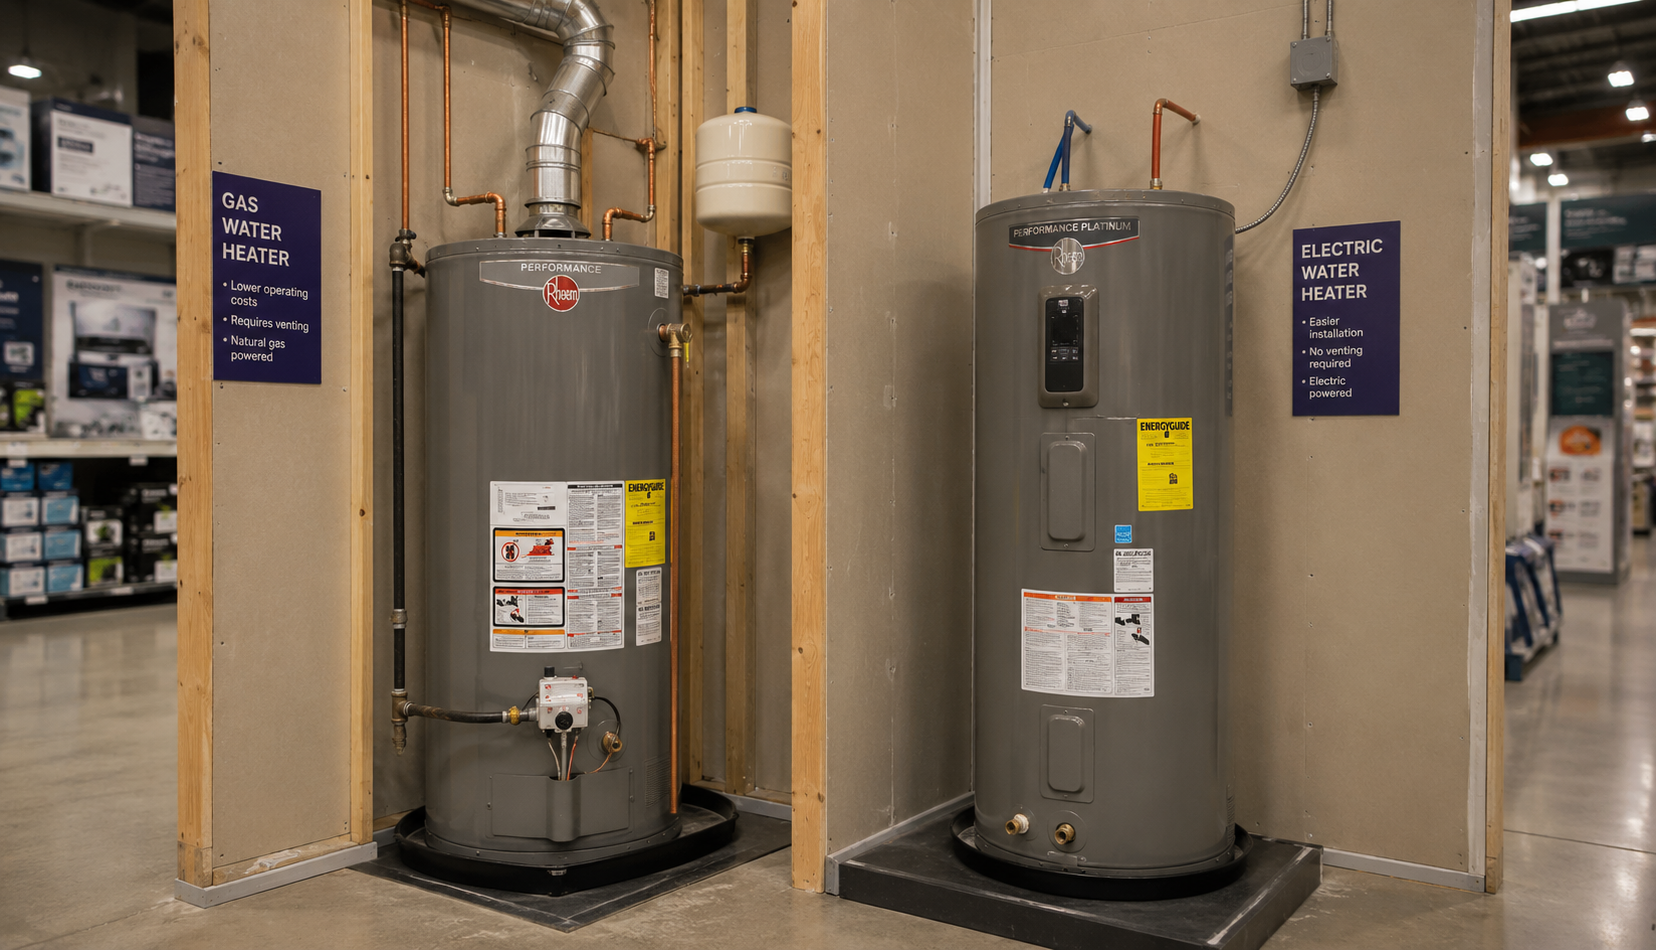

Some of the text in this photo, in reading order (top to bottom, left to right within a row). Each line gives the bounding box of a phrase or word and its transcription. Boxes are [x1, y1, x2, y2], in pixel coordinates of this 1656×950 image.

[222, 192, 258, 213] GAS
[222, 217, 282, 241] WATER
[1014, 222, 1131, 238] PERFORMANCE PLATINUM
[222, 242, 289, 266] HEATER
[1302, 239, 1383, 258] ELECTRIC
[521, 263, 601, 274] PERFORMANCE
[1302, 262, 1359, 280] WATER
[231, 280, 308, 300] Lower operating
[546, 276, 578, 306] Rheem
[1302, 284, 1367, 302] HEATER
[231, 296, 257, 306] costs
[231, 315, 309, 333] Requires venting
[1310, 316, 1340, 326] Easier
[1310, 328, 1363, 339] installation
[231, 335, 286, 350] Natural gas
[231, 350, 273, 362] powered
[1310, 346, 1363, 356] No venting
[1310, 359, 1351, 370] required
[1310, 376, 1346, 386] Electric
[1310, 388, 1352, 400] powered
[1140, 421, 1190, 431] ENERGYGUIDE
